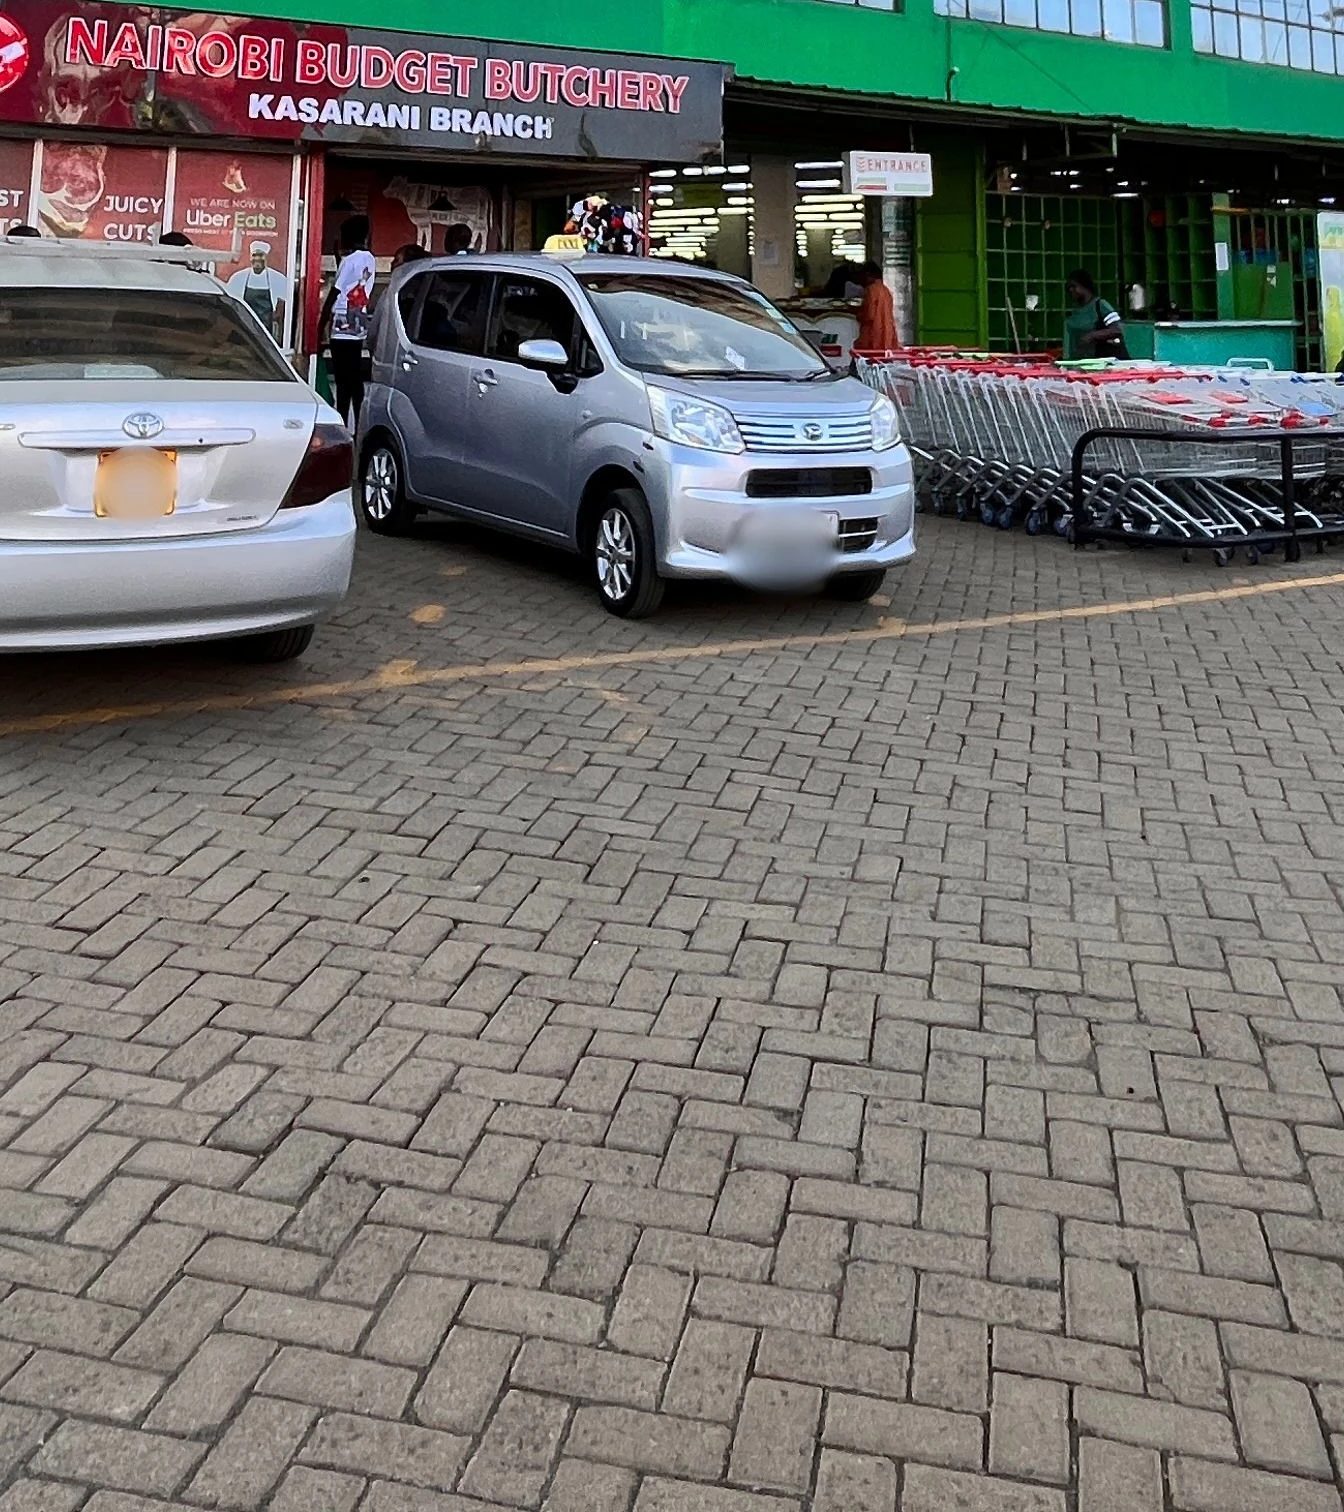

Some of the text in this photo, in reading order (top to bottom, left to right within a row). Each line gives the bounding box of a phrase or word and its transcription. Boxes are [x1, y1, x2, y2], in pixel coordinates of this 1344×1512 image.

[65, 16, 690, 114] NAIROBI BUDGET BUTCHERY
[248, 93, 553, 140] KASARANI BRANCH
[867, 159, 928, 173] ENTRANCE
[103, 195, 164, 215] JUICY
[186, 208, 277, 229] Uber Eats
